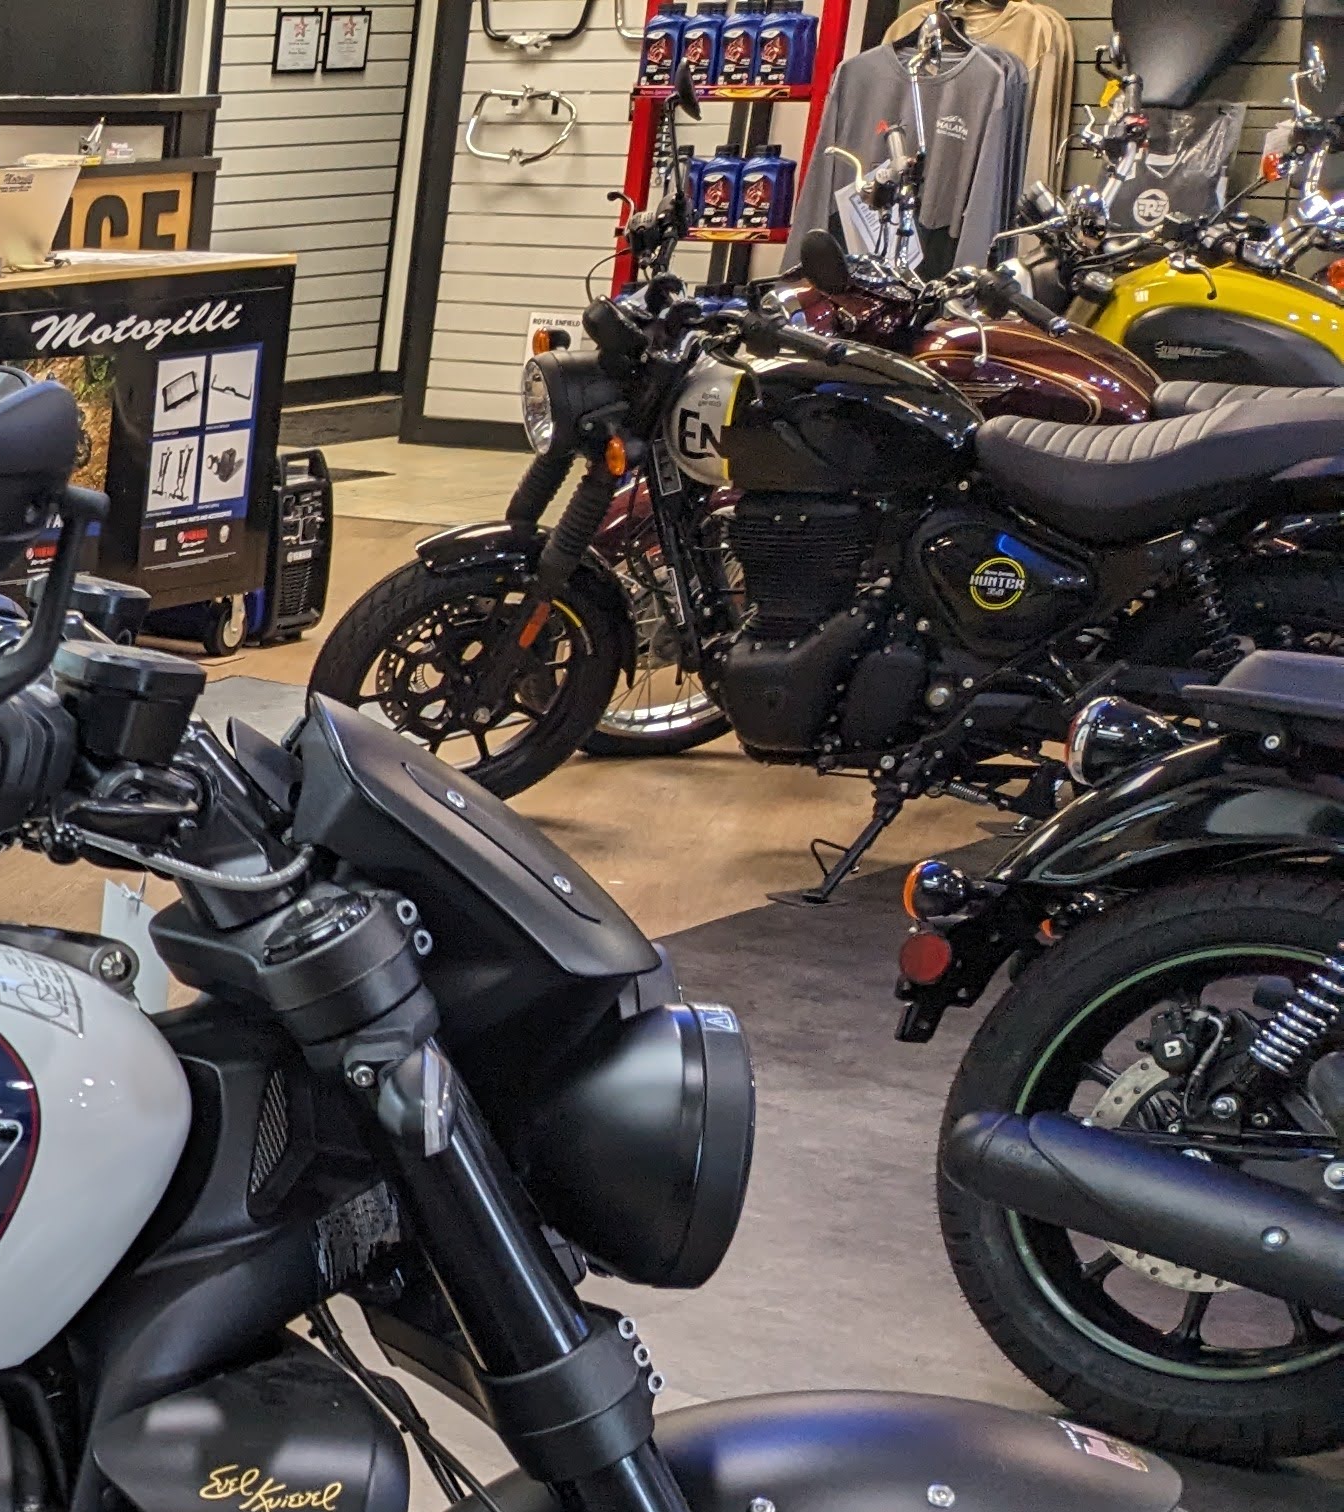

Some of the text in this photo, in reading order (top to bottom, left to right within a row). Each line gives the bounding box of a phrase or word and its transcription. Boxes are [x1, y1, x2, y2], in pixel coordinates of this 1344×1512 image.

[30, 300, 243, 351] Motozilli
[532, 318, 581, 327] ROYAL ENFIELD
[969, 574, 1026, 591] HUNTER
